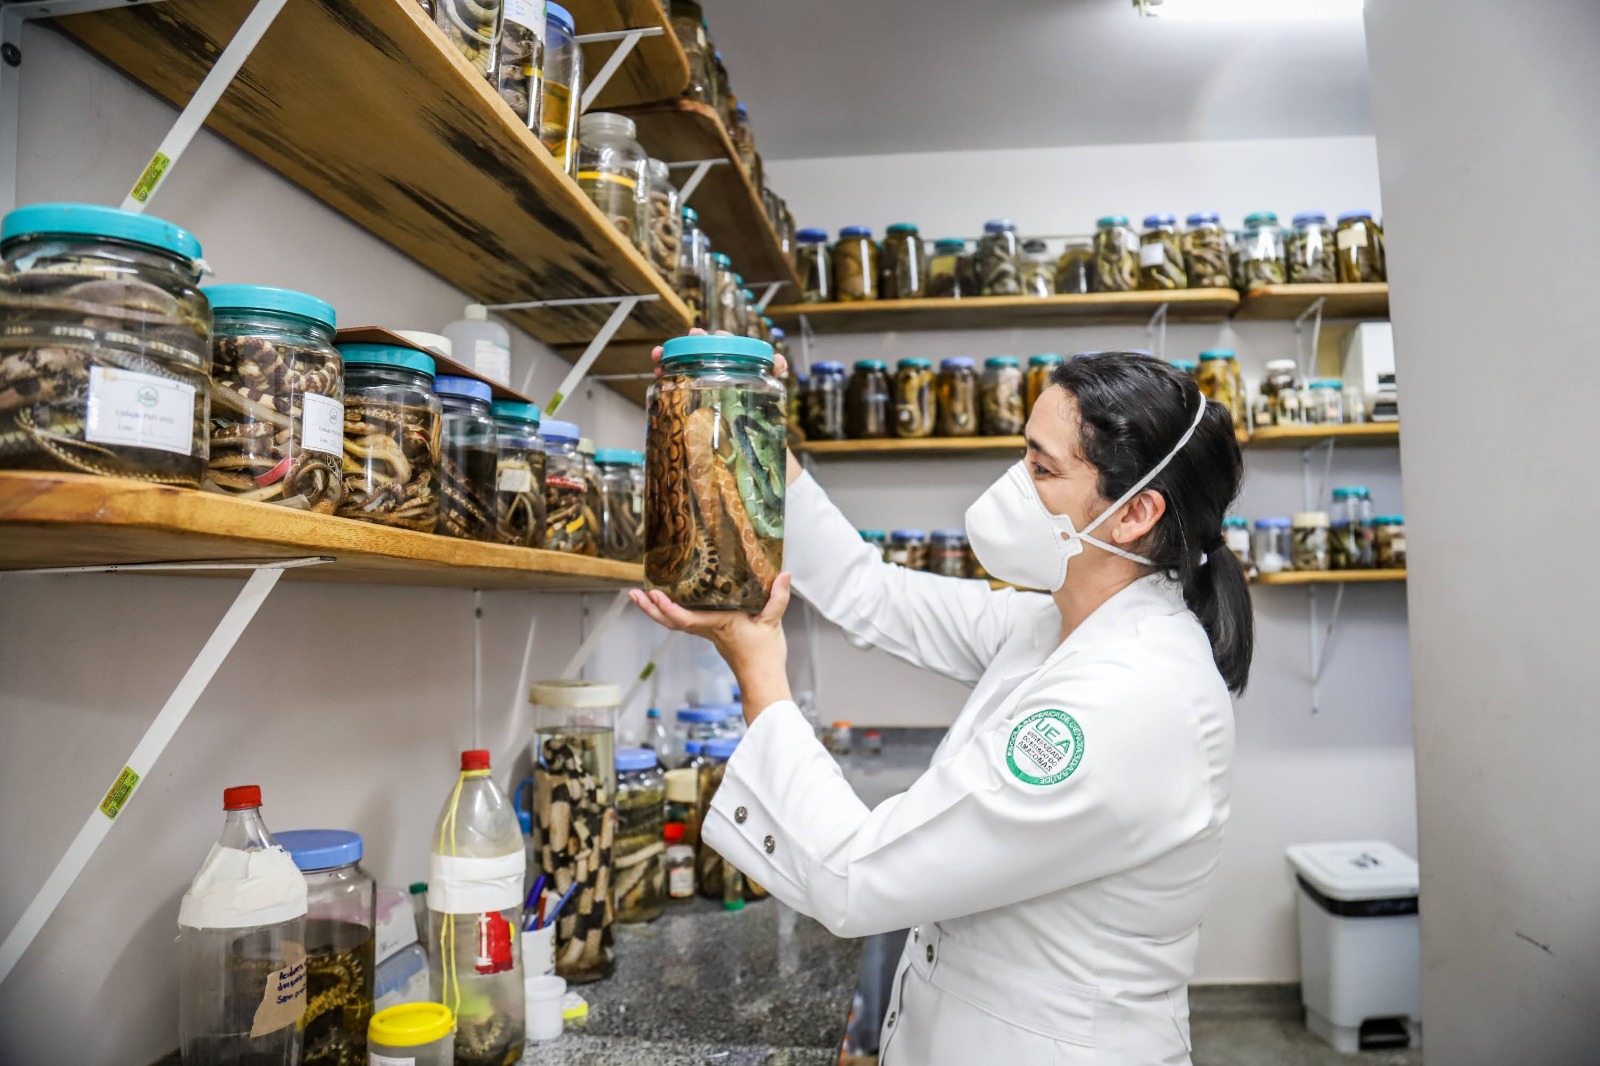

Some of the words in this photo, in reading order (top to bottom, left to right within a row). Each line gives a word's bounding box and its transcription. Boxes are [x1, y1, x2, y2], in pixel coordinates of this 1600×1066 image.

[1022, 735, 1031, 744] DO
[1029, 741, 1049, 759] ESTADO
[1047, 758, 1058, 767] DO
[1027, 731, 1064, 762] UNIVERSIDADE
[1036, 718, 1071, 754] UEA
[1018, 740, 1053, 772] AMAZONAS
